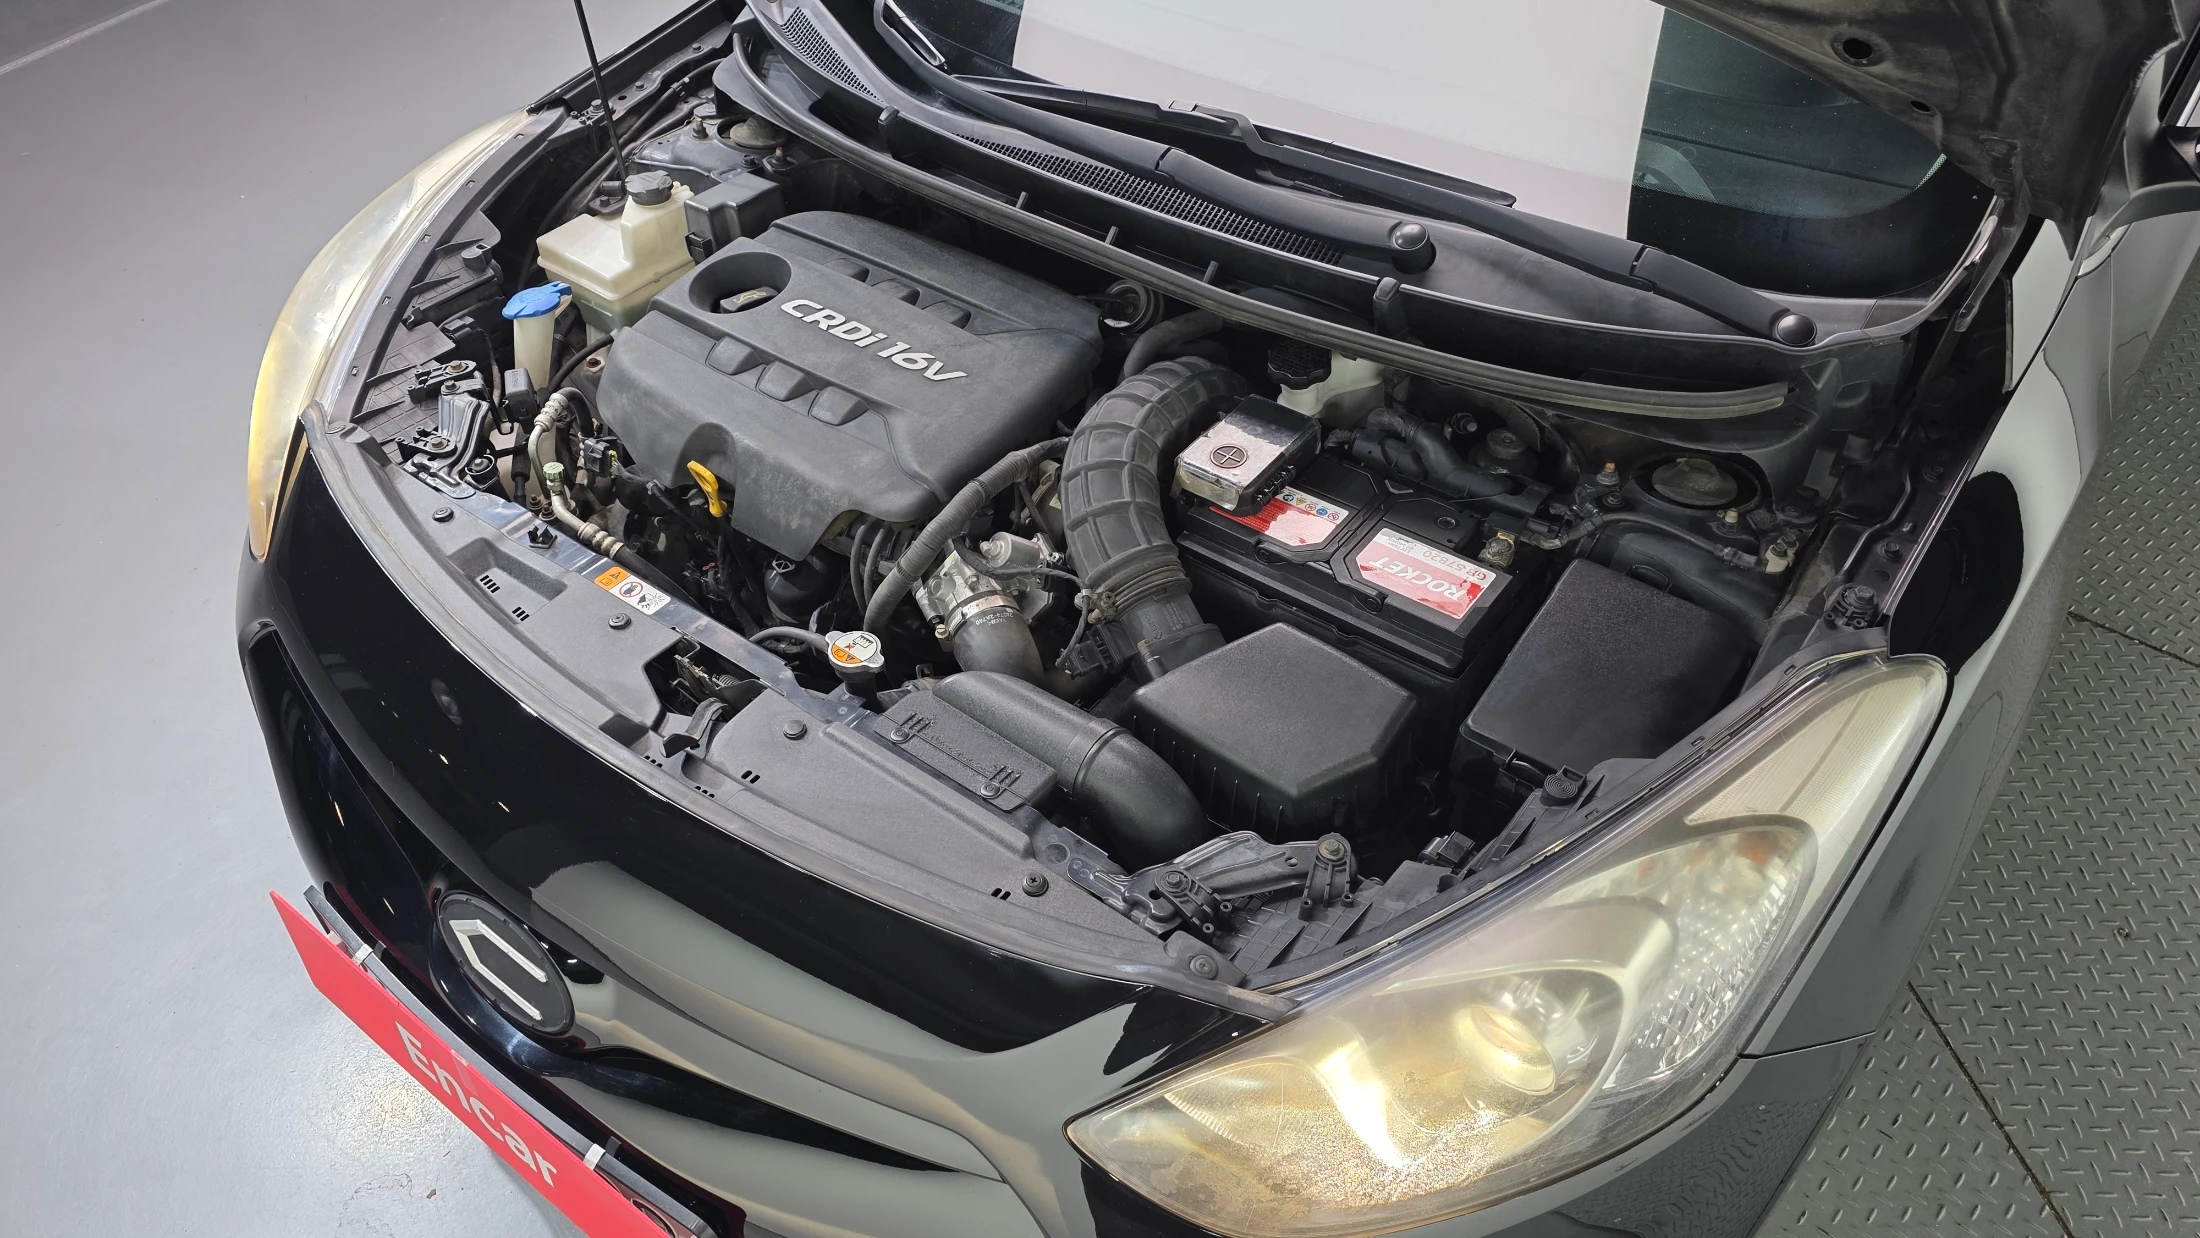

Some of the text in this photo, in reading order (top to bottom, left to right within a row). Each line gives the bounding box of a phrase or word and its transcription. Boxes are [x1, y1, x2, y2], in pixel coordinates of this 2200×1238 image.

[780, 299, 969, 381] CRDi 16V
[1368, 556, 1467, 601] ROCKET
[1423, 550, 1487, 581] GB 57820
[394, 1020, 558, 1188] Encar
